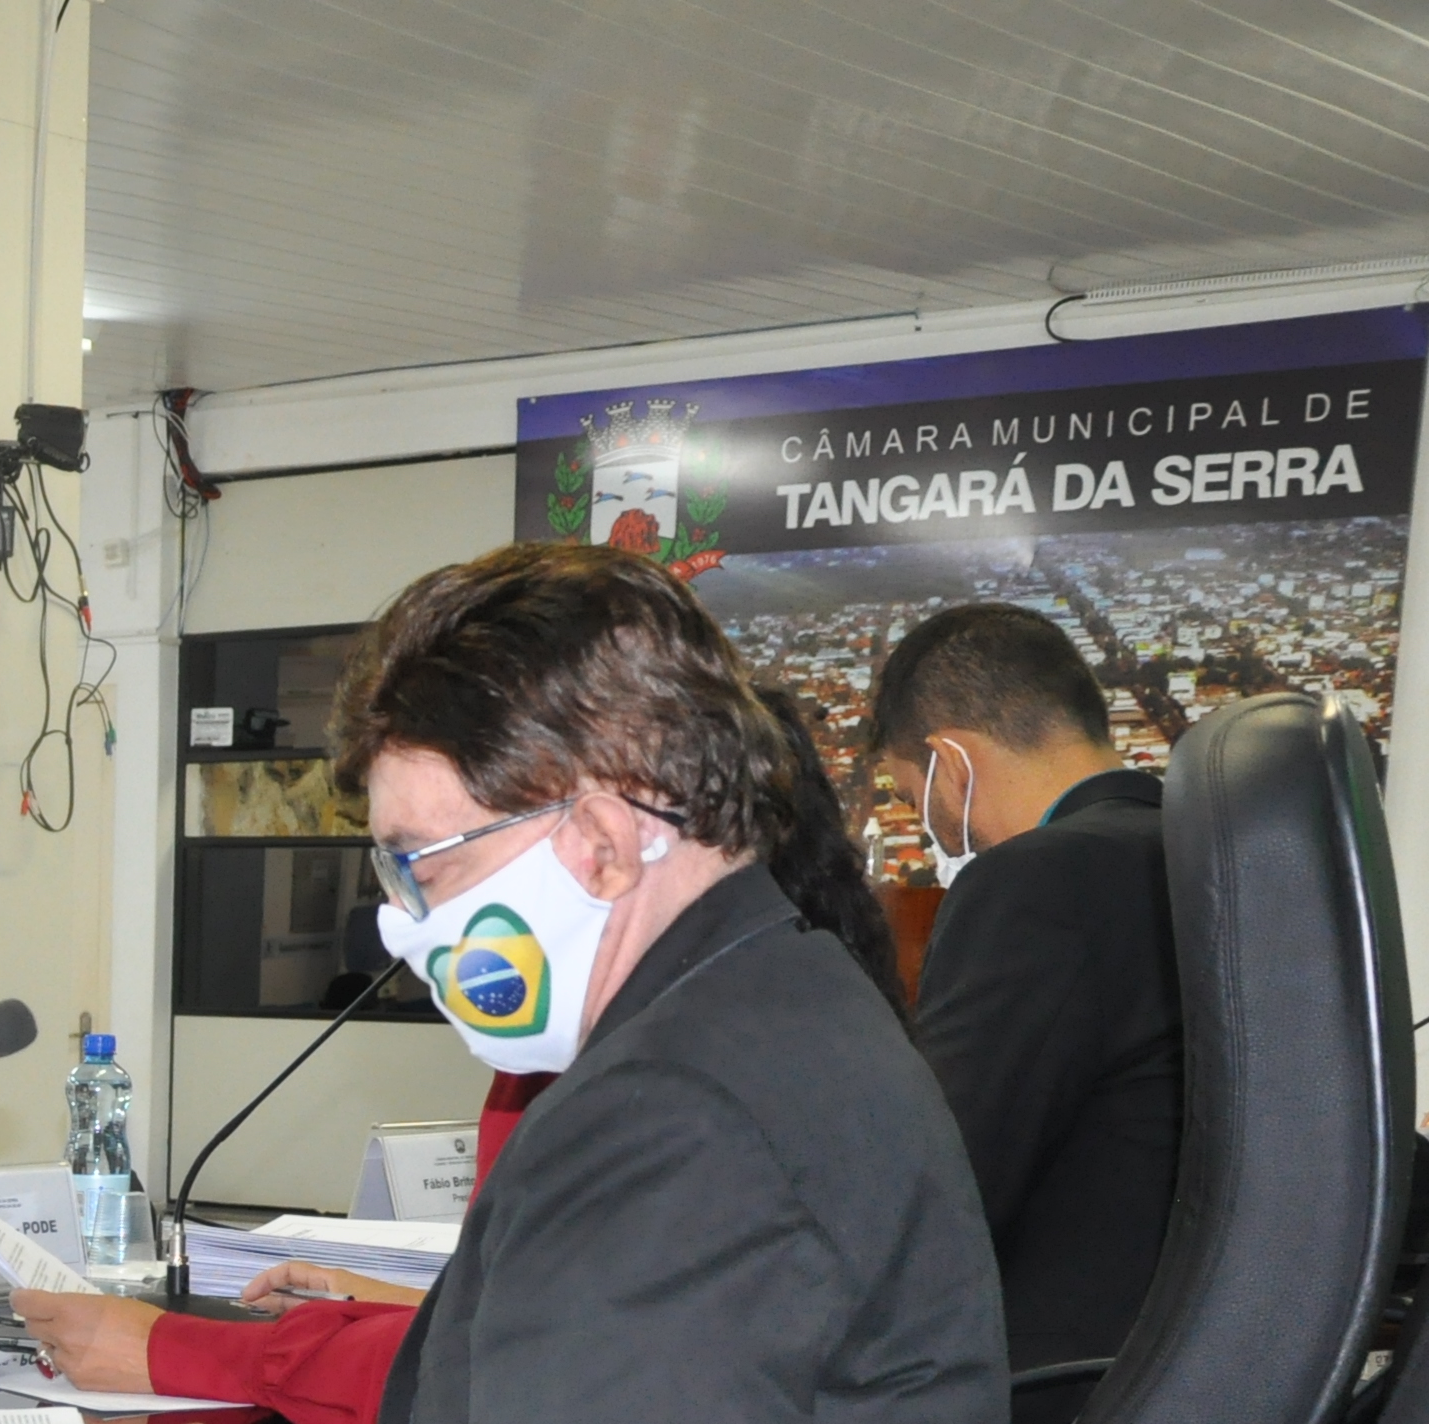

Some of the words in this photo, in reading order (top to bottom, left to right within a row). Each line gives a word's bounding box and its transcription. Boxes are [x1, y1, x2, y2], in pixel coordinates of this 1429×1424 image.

[781, 423, 972, 465] CÂMARA
[992, 397, 1281, 447] MUNICIPAL
[1305, 388, 1372, 423] DE
[776, 452, 1037, 530] TANGARÁ
[1052, 460, 1136, 512] DA
[1151, 443, 1365, 507] SERRA
[22, 1219, 58, 1235] PODE
